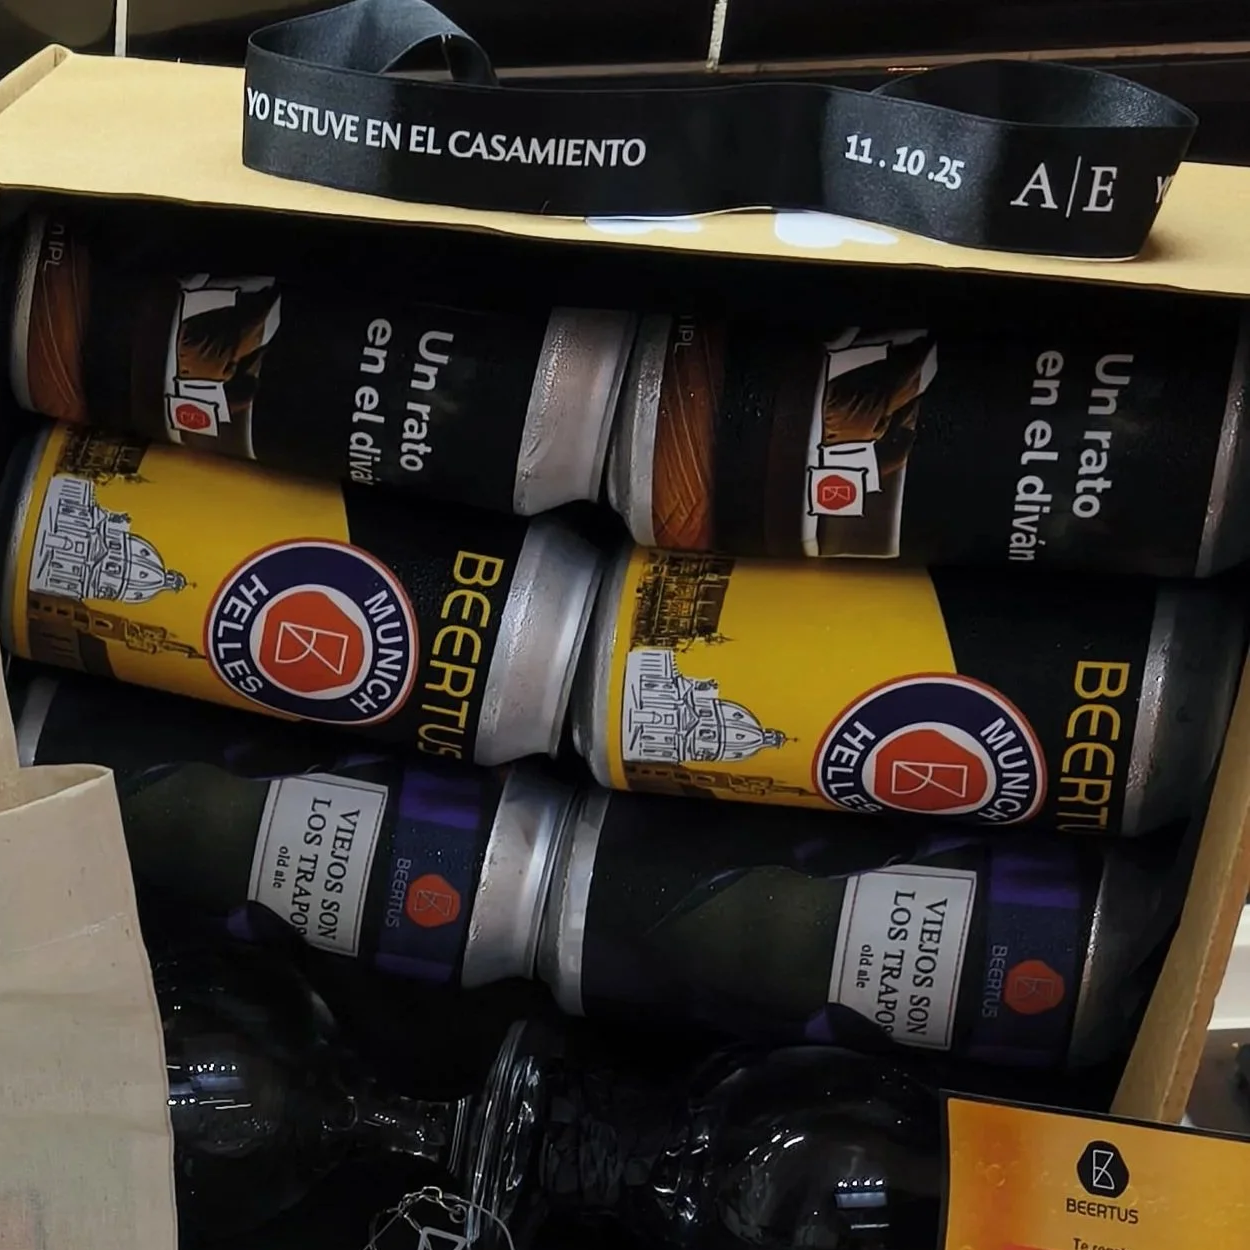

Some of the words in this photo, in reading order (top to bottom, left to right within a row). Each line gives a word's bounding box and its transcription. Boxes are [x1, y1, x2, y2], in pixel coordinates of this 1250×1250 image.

[247, 87, 270, 120] YO
[273, 98, 359, 143] ESTUVE
[365, 118, 402, 150] EN
[410, 125, 442, 155] EL
[449, 130, 646, 167] CASAMIENTO
[360, 318, 393, 374] en
[410, 330, 454, 391] Un
[352, 386, 385, 424] el
[1029, 350, 1065, 406] en
[1087, 353, 1134, 417] Un
[400, 401, 433, 471] rato
[1020, 419, 1059, 466] el
[1072, 430, 1114, 519] rato
[1008, 475, 1053, 562] diván
[210, 574, 270, 695] HELLES
[349, 589, 405, 715] MUNICH
[822, 720, 883, 815] HELLES
[978, 717, 1030, 821] MUNICH
[303, 797, 332, 847] LOS
[324, 809, 361, 894] VIEJOS
[272, 870, 287, 889] ale
[277, 846, 291, 868] old
[317, 899, 341, 940] SON
[385, 857, 412, 928] BEERTUS
[887, 890, 916, 942] LOS
[862, 944, 875, 970] old
[913, 898, 948, 988] VIEJOS
[855, 972, 870, 989] ale
[982, 945, 1008, 1019] BEERTUS
[906, 995, 931, 1036] SON
[1066, 1198, 1139, 1225] BEERTUS
